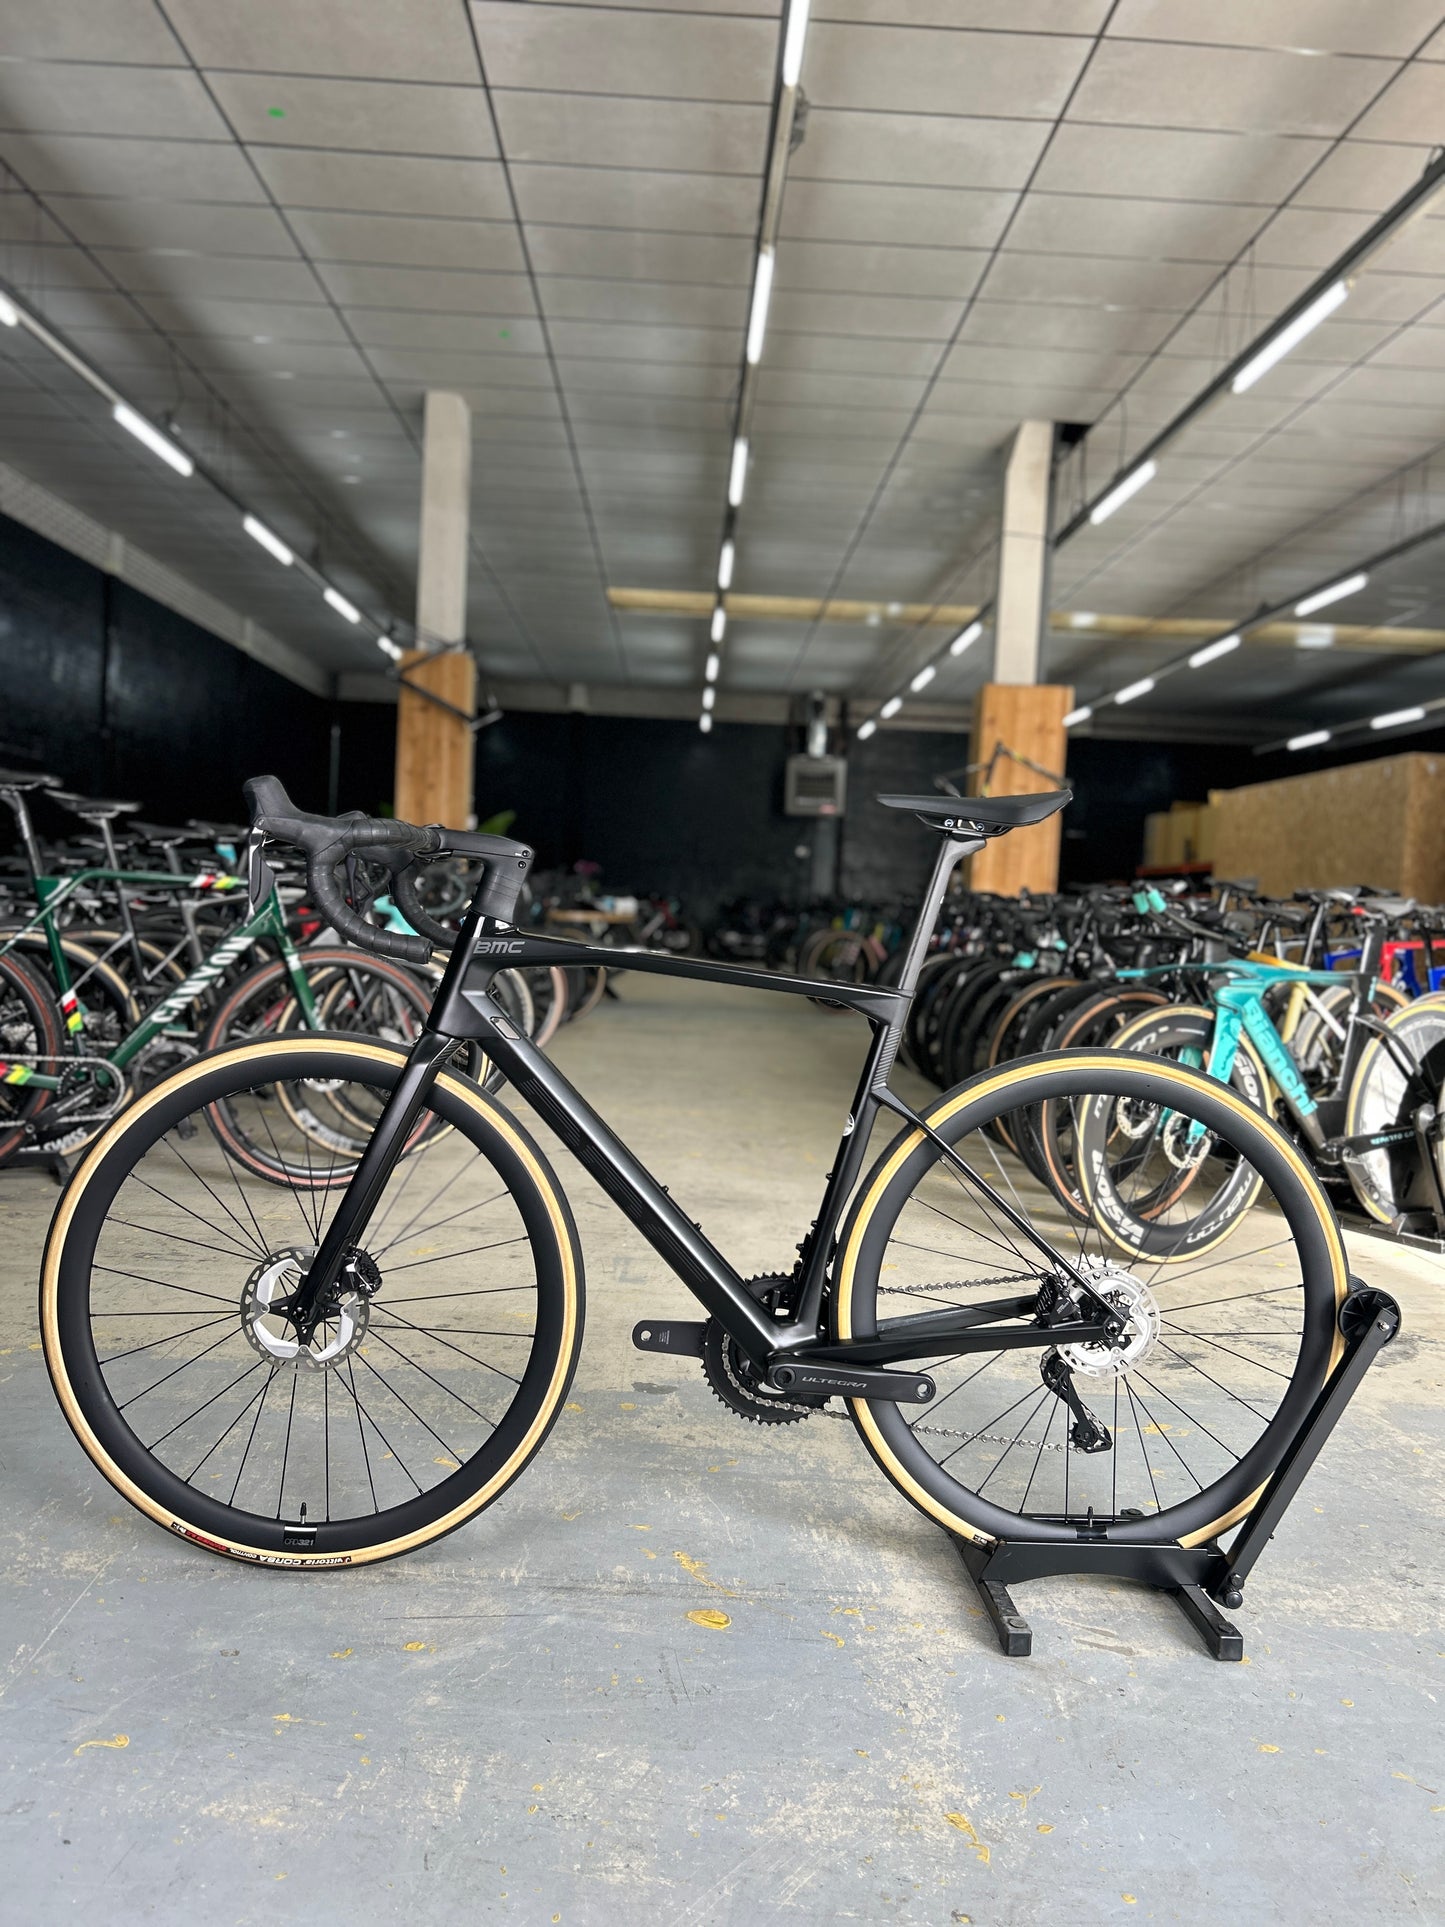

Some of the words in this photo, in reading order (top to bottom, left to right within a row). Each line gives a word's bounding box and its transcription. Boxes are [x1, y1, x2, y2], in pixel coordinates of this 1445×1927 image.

[473, 940, 525, 954] BMC
[150, 935, 255, 1025] CANYON
[1243, 998, 1319, 1117] Bianchi
[43, 1126, 88, 1151] SWISS
[802, 1375, 868, 1388] ULTEGRA
[229, 1548, 257, 1558] CONTROL
[259, 1555, 302, 1566] CORSA
[304, 1557, 343, 1565] vittoria
